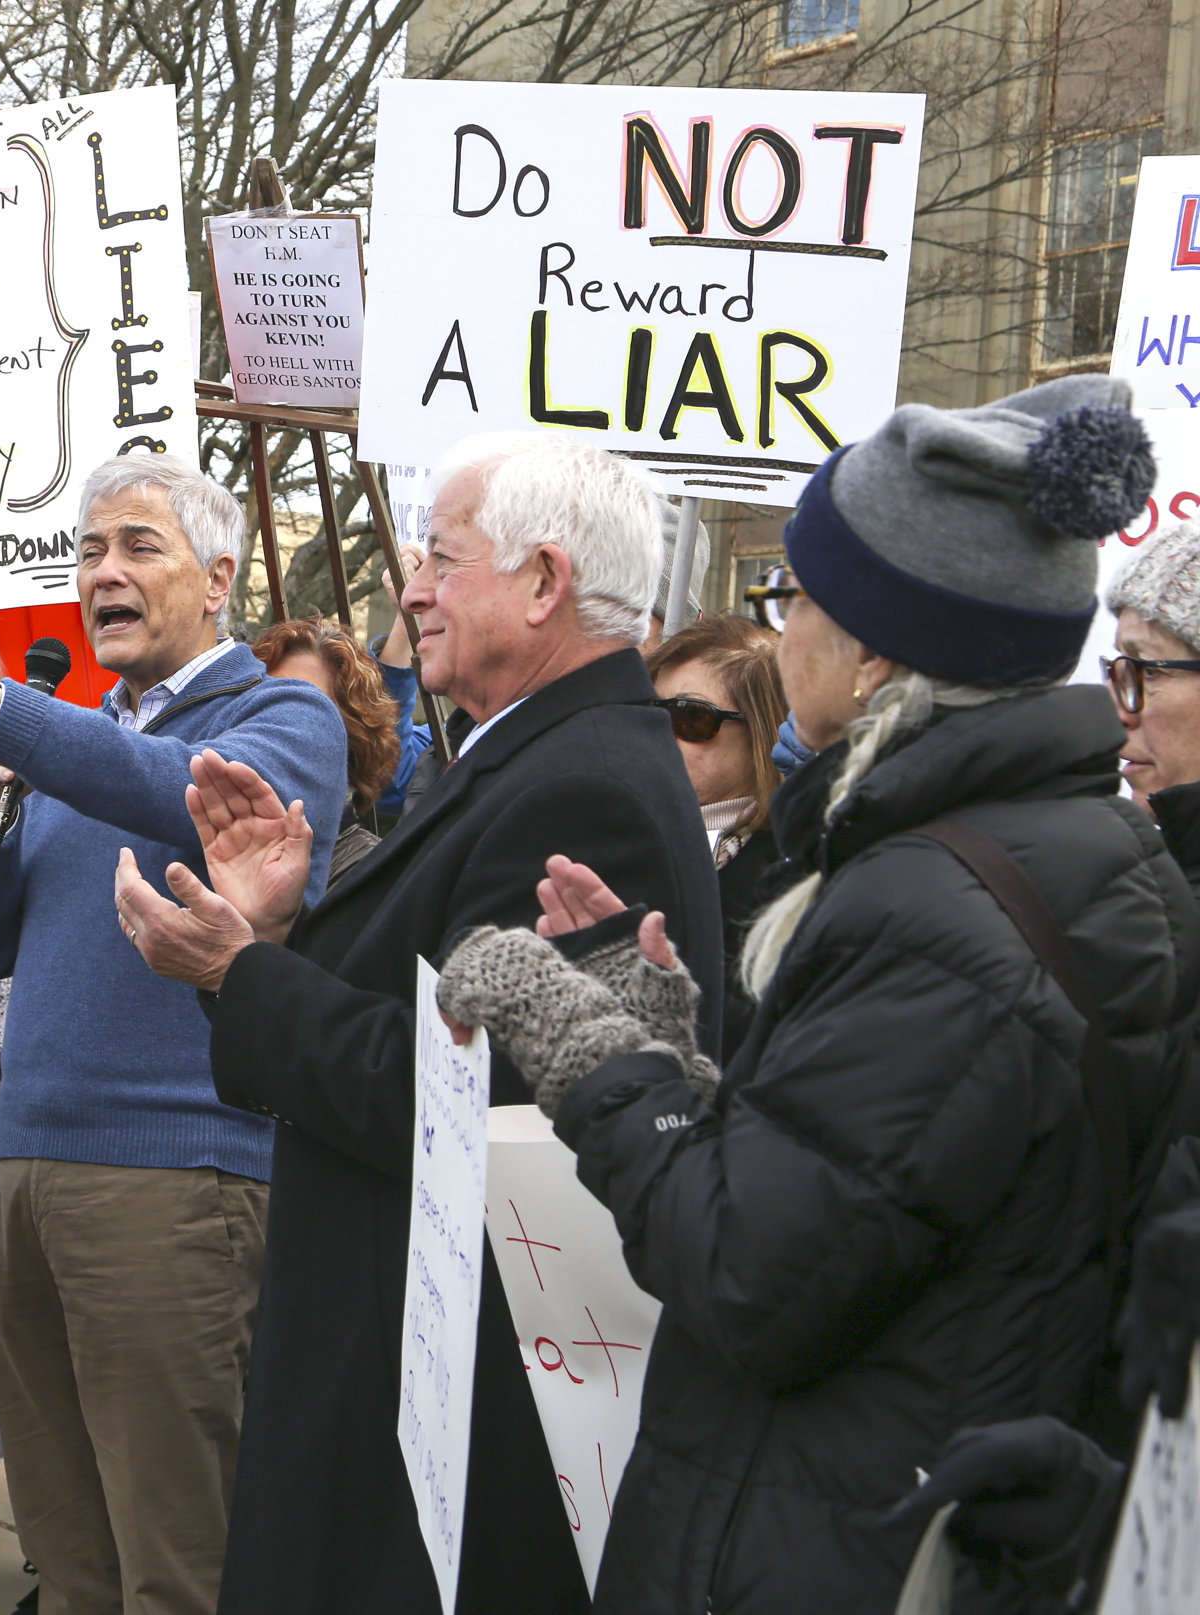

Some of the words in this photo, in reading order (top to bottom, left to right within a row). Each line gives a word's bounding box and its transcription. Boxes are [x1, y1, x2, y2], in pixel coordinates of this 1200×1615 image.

[42, 103, 84, 141] ALL
[453, 124, 550, 217] Do
[621, 111, 905, 246] NOT
[231, 225, 284, 240] DON'T
[289, 225, 332, 240] SEAT
[234, 273, 257, 287] HE
[262, 273, 278, 287] IS
[282, 273, 341, 288] GOING
[538, 242, 754, 322] Reward
[87, 132, 173, 456] LIE
[250, 293, 275, 307] TO
[279, 294, 327, 308] TURN
[234, 312, 309, 328] AGAINST
[313, 314, 351, 329] YOU
[265, 332, 325, 347] KEVIN!
[243, 355, 265, 368] TO
[269, 356, 309, 370] HELL
[312, 357, 354, 372] WITH
[236, 372, 300, 388] GEORGE
[303, 374, 361, 389] SANTOS
[421, 319, 478, 413] A
[527, 311, 842, 454] LIAR
